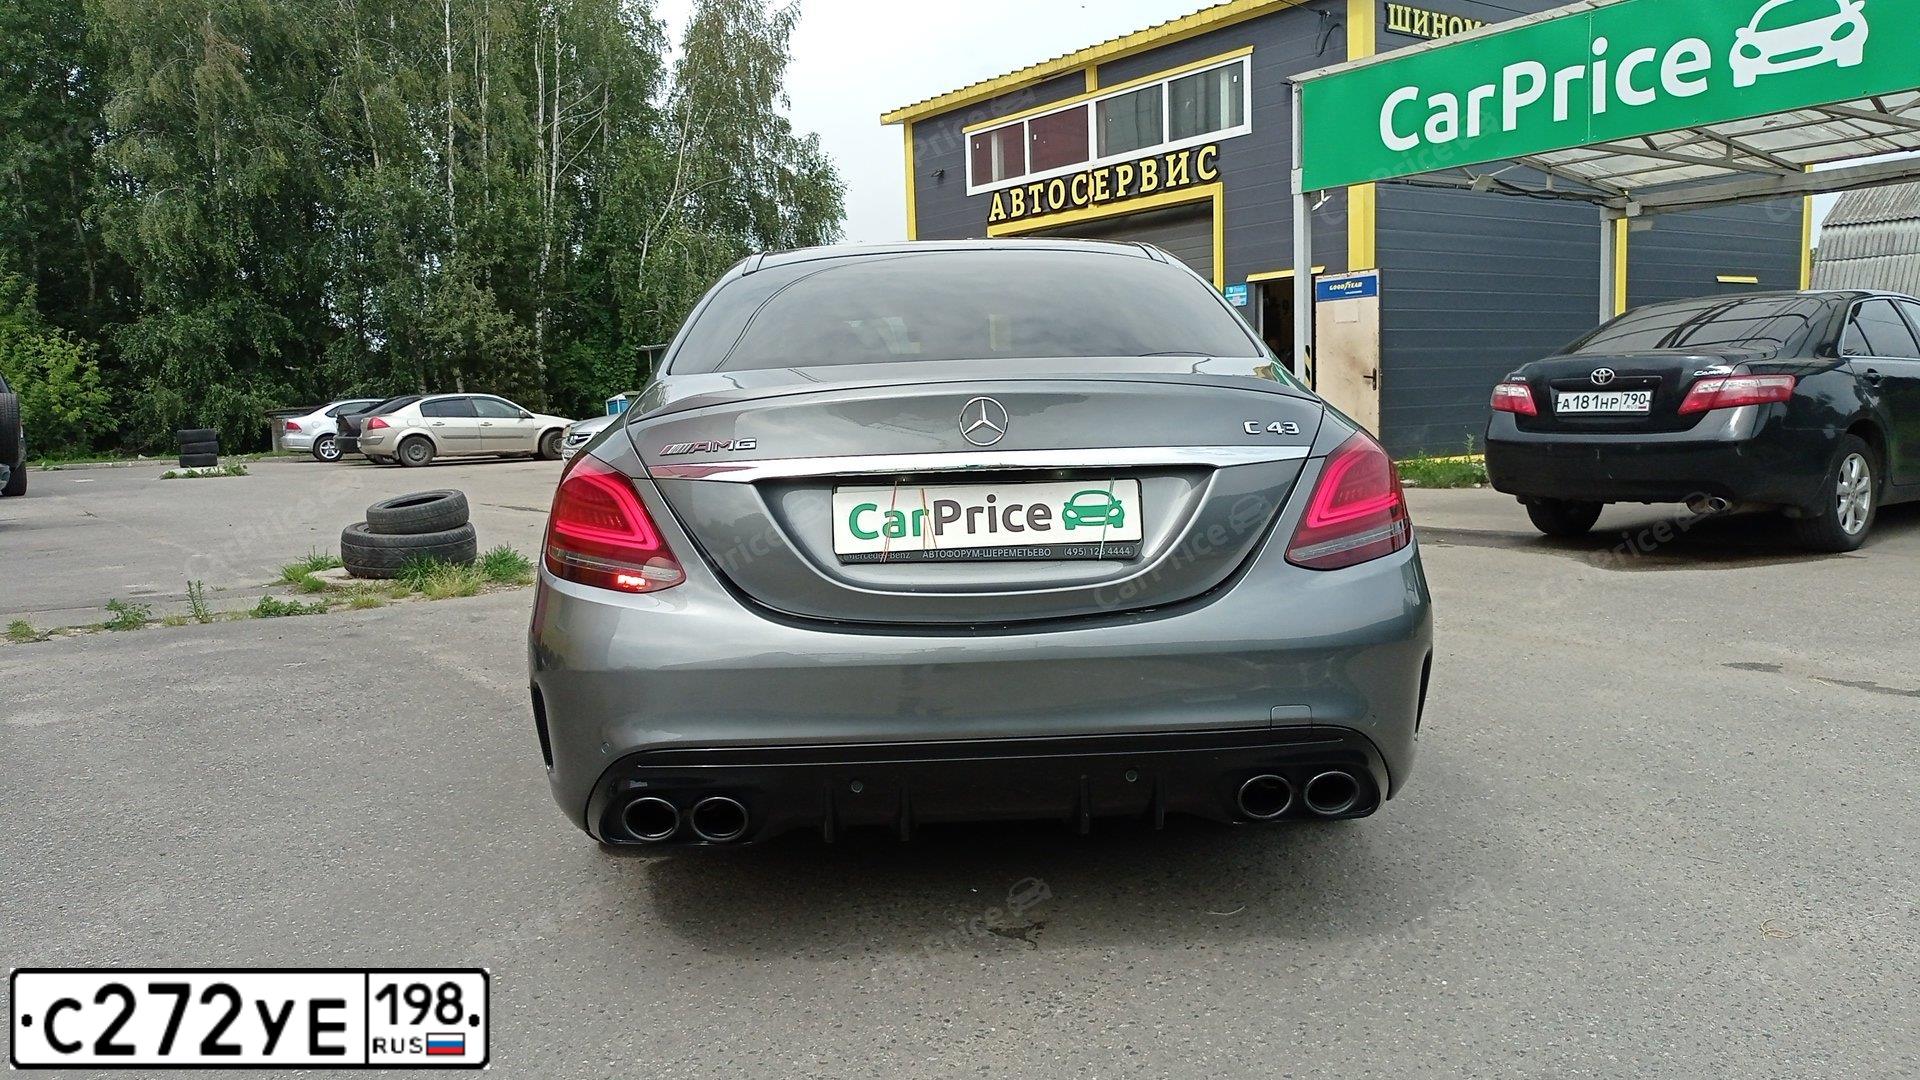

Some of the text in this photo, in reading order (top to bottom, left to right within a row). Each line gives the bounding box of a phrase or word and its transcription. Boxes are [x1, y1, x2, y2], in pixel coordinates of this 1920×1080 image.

[1388, 4, 1492, 38] ШИНО
[1380, 37, 1712, 151] CarPrice
[989, 145, 1218, 222] АВТОСЕРВИС
[1623, 393, 1647, 405] 790
[1243, 421, 1300, 435] C 43
[849, 494, 1052, 540] CarPrice
[1064, 547, 1087, 556] (495)
[1107, 546, 1131, 555] 4444
